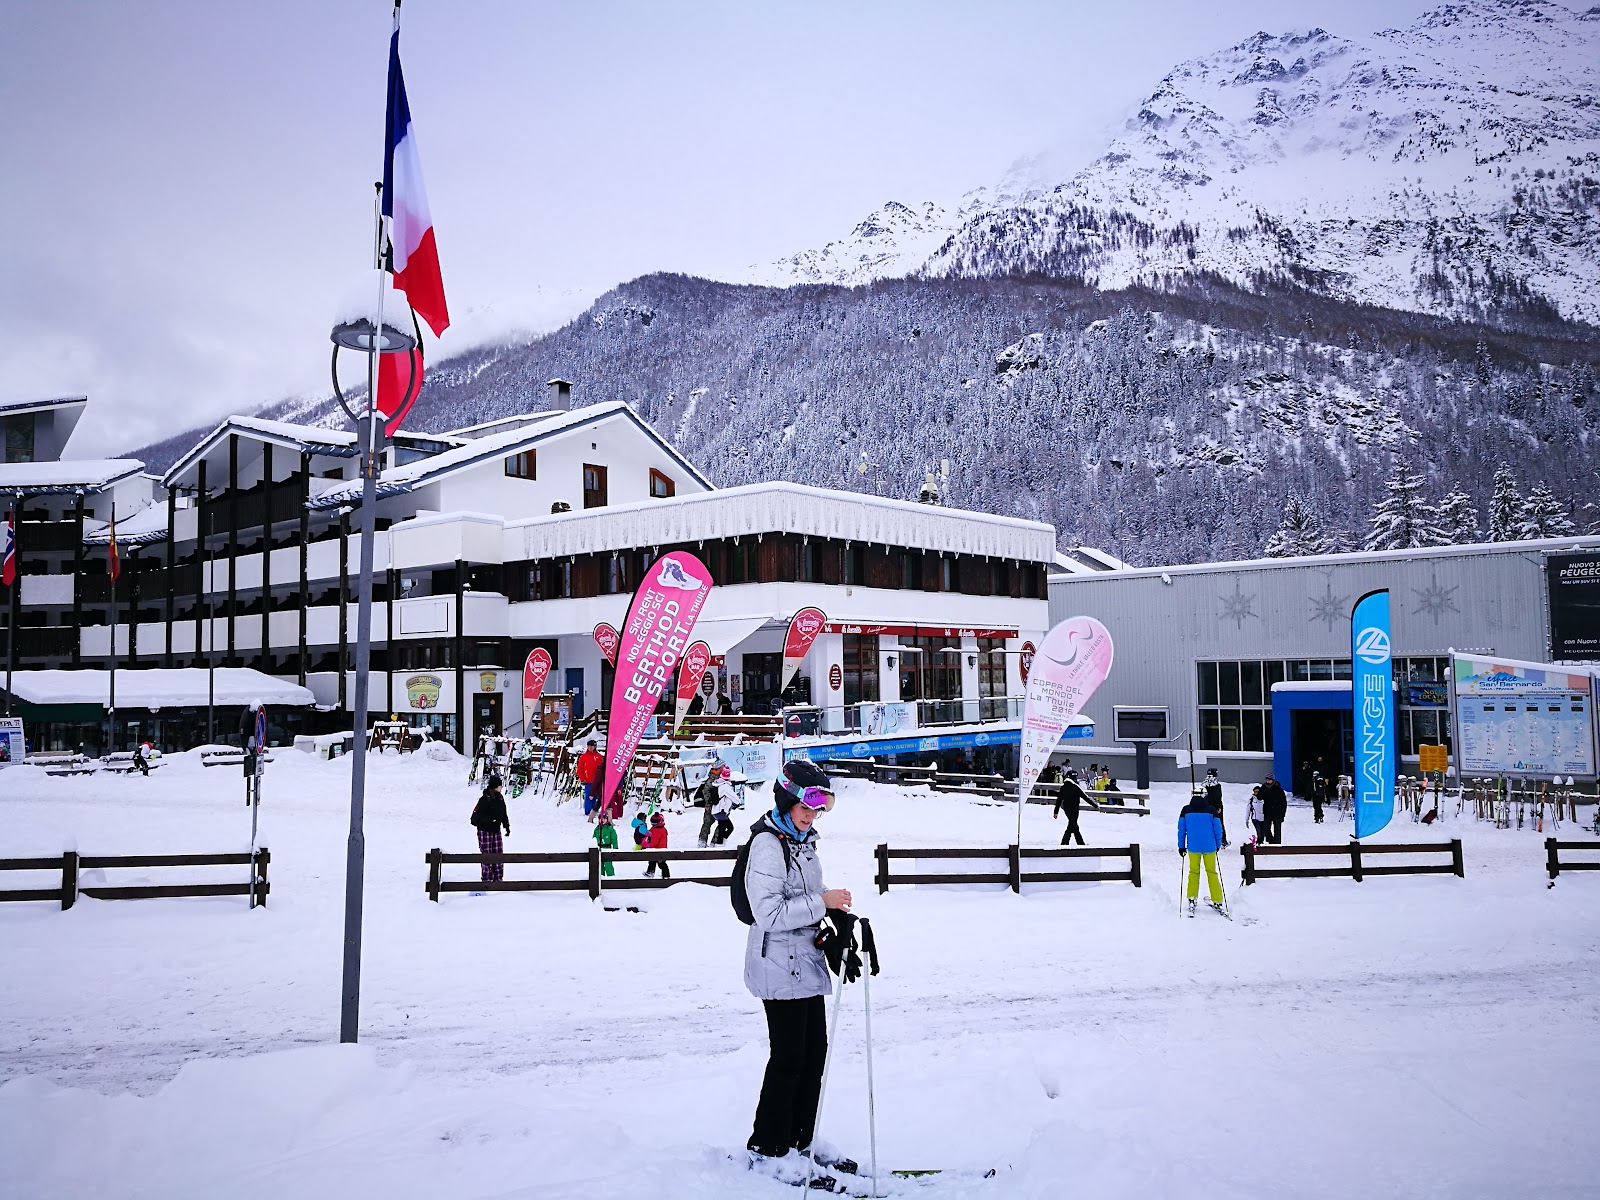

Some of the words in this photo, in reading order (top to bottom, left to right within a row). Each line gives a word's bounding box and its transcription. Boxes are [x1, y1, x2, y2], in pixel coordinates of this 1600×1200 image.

[1568, 561, 1595, 569] NUOVO
[629, 616, 643, 636] SKI
[638, 587, 657, 617] RENT
[684, 614, 696, 626] LA
[690, 583, 709, 613] THUILE
[626, 611, 657, 664] NOLEGGIO
[651, 592, 666, 611] SCI
[623, 599, 680, 705] BERTHOD
[646, 620, 689, 698] SPORT
[1032, 678, 1064, 691] COPPA
[1065, 685, 1084, 696] DEL
[1041, 687, 1073, 700] MONDO
[1486, 676, 1519, 685] espace
[1030, 692, 1042, 702] La
[1045, 695, 1075, 709] Thuile
[1051, 705, 1073, 716] 2016
[616, 702, 654, 773] berthodsport.it
[1362, 674, 1386, 804] LANGE
[612, 744, 627, 765] 0165
